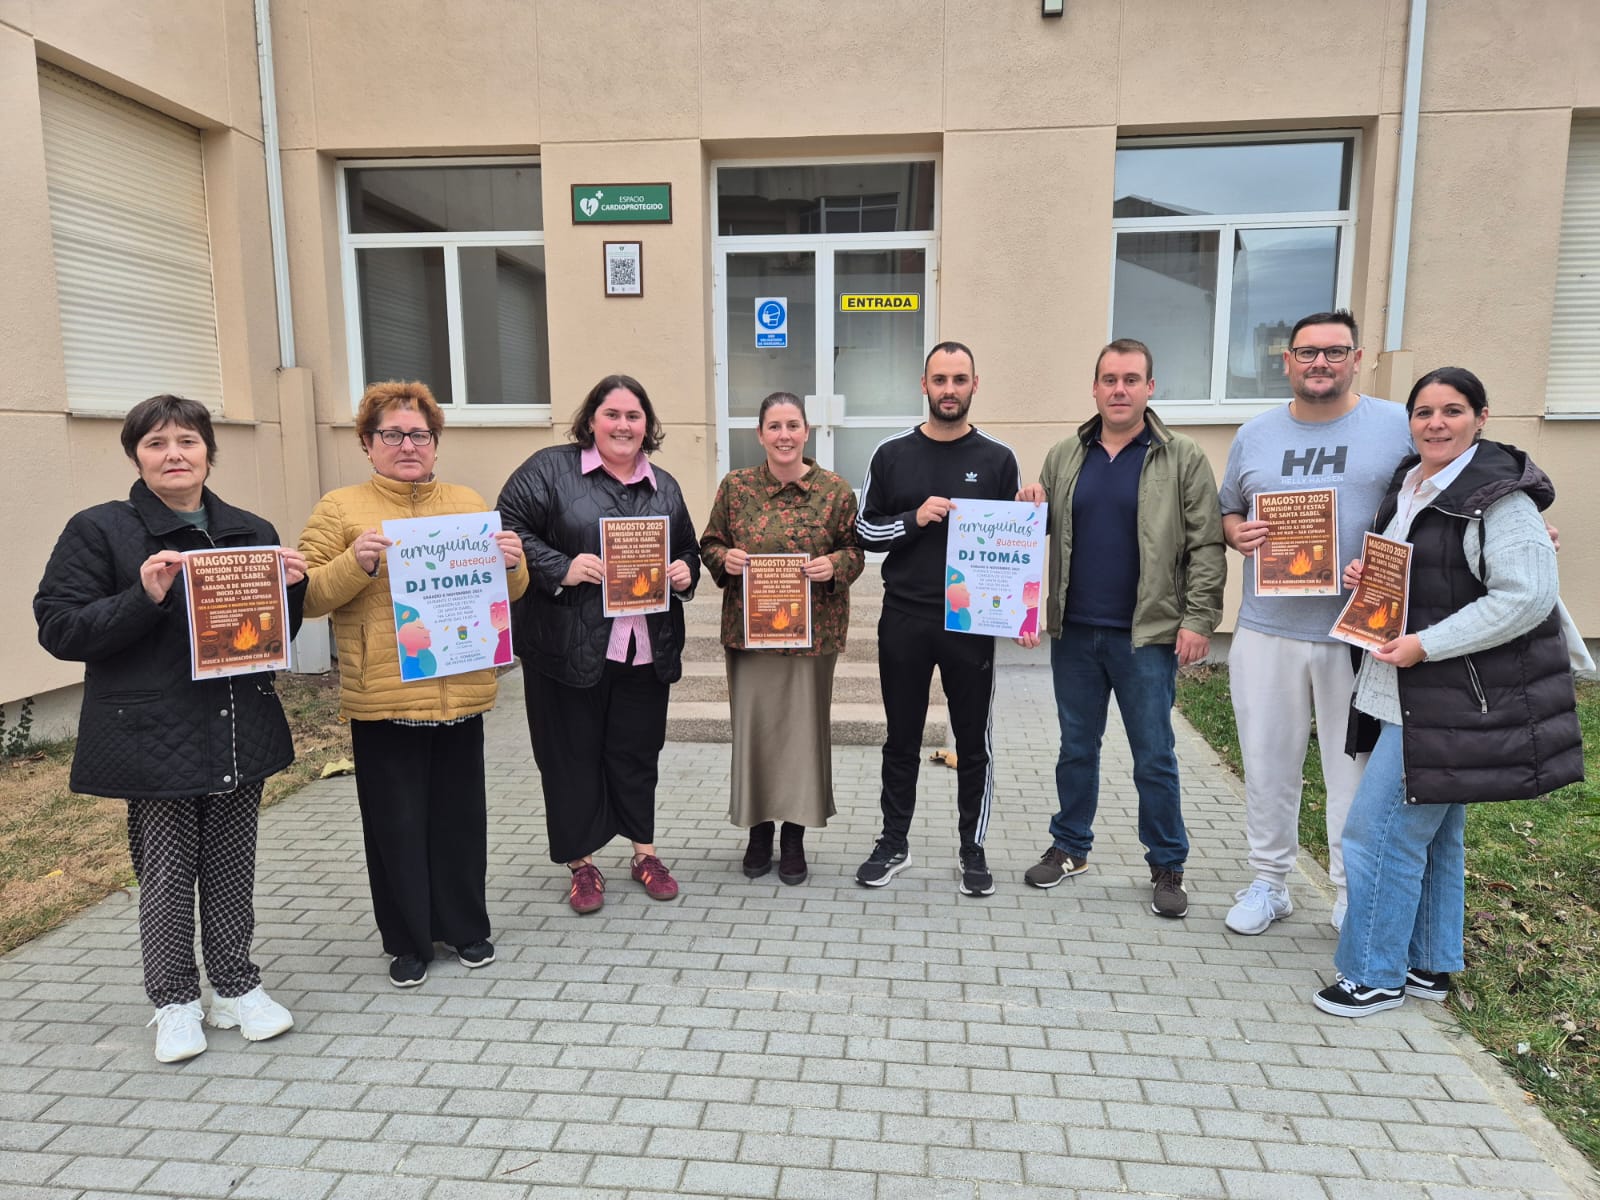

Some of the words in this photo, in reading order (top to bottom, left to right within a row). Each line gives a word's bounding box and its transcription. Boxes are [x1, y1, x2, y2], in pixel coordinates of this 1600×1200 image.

[619, 195, 645, 203] ESPACIO
[601, 203, 663, 211] CARDIOPROTEGIDO
[848, 297, 913, 308] ENTRADA
[1281, 446, 1348, 476] HH
[1262, 496, 1306, 506] MAGOSTO
[1308, 494, 1329, 503] 2025
[1263, 505, 1292, 513] COMISIÓN
[607, 522, 645, 531] MAGOSTO
[646, 522, 663, 530] 2025
[996, 538, 1038, 550] guateque
[1369, 538, 1394, 554] MAGOSTO
[1394, 544, 1407, 558] 2025
[193, 555, 247, 567] MAGOSTO
[249, 554, 274, 564] 2025
[449, 555, 497, 569] guateque
[787, 559, 804, 567] 2025
[959, 550, 974, 561] DJ
[979, 550, 1030, 564] TOMÁS
[195, 566, 231, 575] COMISIÓN
[406, 580, 426, 593] DJ
[432, 570, 492, 590] TOMÁS
